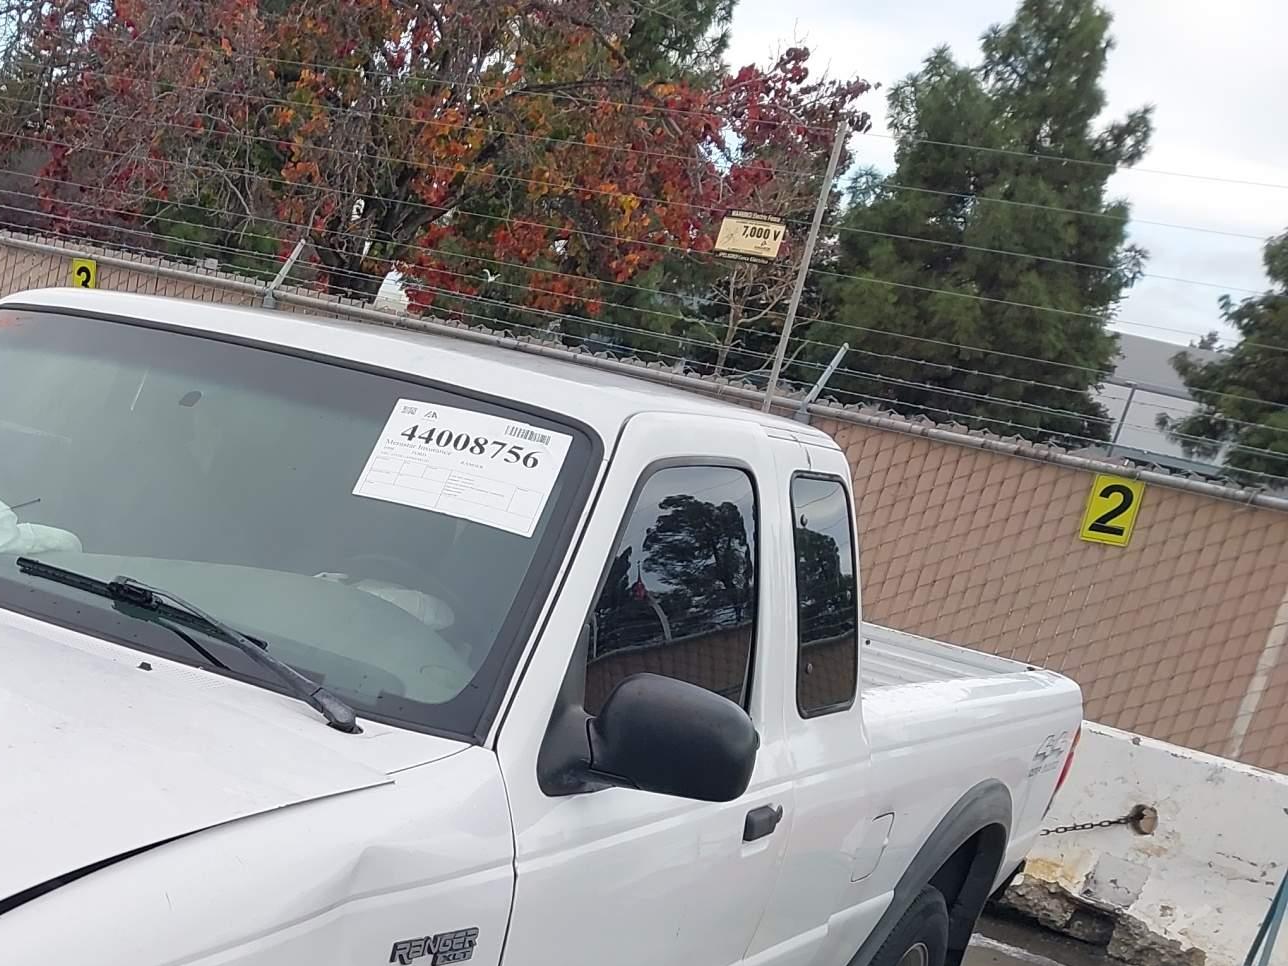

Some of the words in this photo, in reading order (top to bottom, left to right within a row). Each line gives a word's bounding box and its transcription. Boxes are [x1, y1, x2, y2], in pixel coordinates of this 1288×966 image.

[741, 224, 771, 240] 7,000
[773, 229, 781, 241] V
[400, 424, 544, 469] 44008756
[1088, 484, 1134, 536] 2
[389, 926, 479, 965] RANGER
